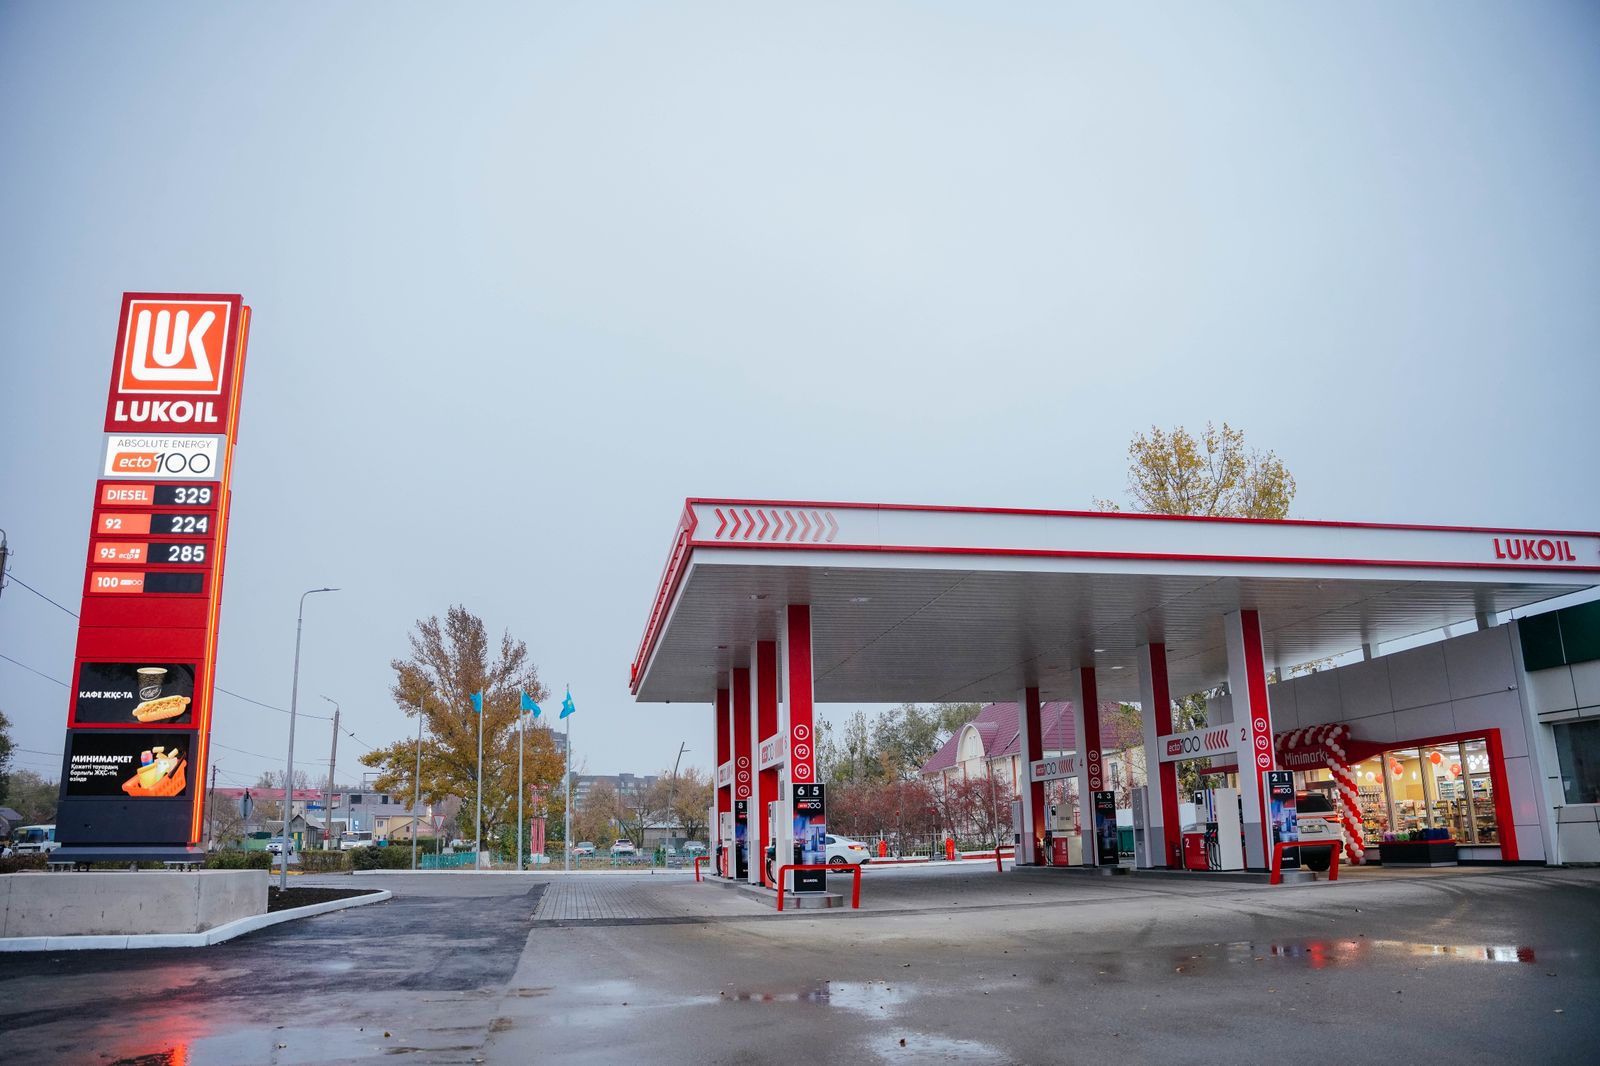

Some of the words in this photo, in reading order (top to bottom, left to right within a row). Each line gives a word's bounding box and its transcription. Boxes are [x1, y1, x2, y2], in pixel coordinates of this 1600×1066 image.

[114, 400, 218, 423] LUKOIL
[117, 439, 169, 448] ABSOLUTE
[172, 440, 212, 448] ENERGY
[107, 490, 148, 500] DIESEL
[174, 488, 210, 504] 329
[105, 518, 122, 529] 92
[171, 516, 208, 532] 224
[100, 548, 116, 558] 95
[168, 546, 204, 562] 285
[1493, 538, 1576, 562] LUKOIL
[98, 576, 118, 588] 100
[1240, 728, 1246, 741] 2
[1284, 773, 1288, 781] 1
[797, 786, 805, 795] 6
[812, 786, 819, 795] 5
[1185, 838, 1190, 848] 2
